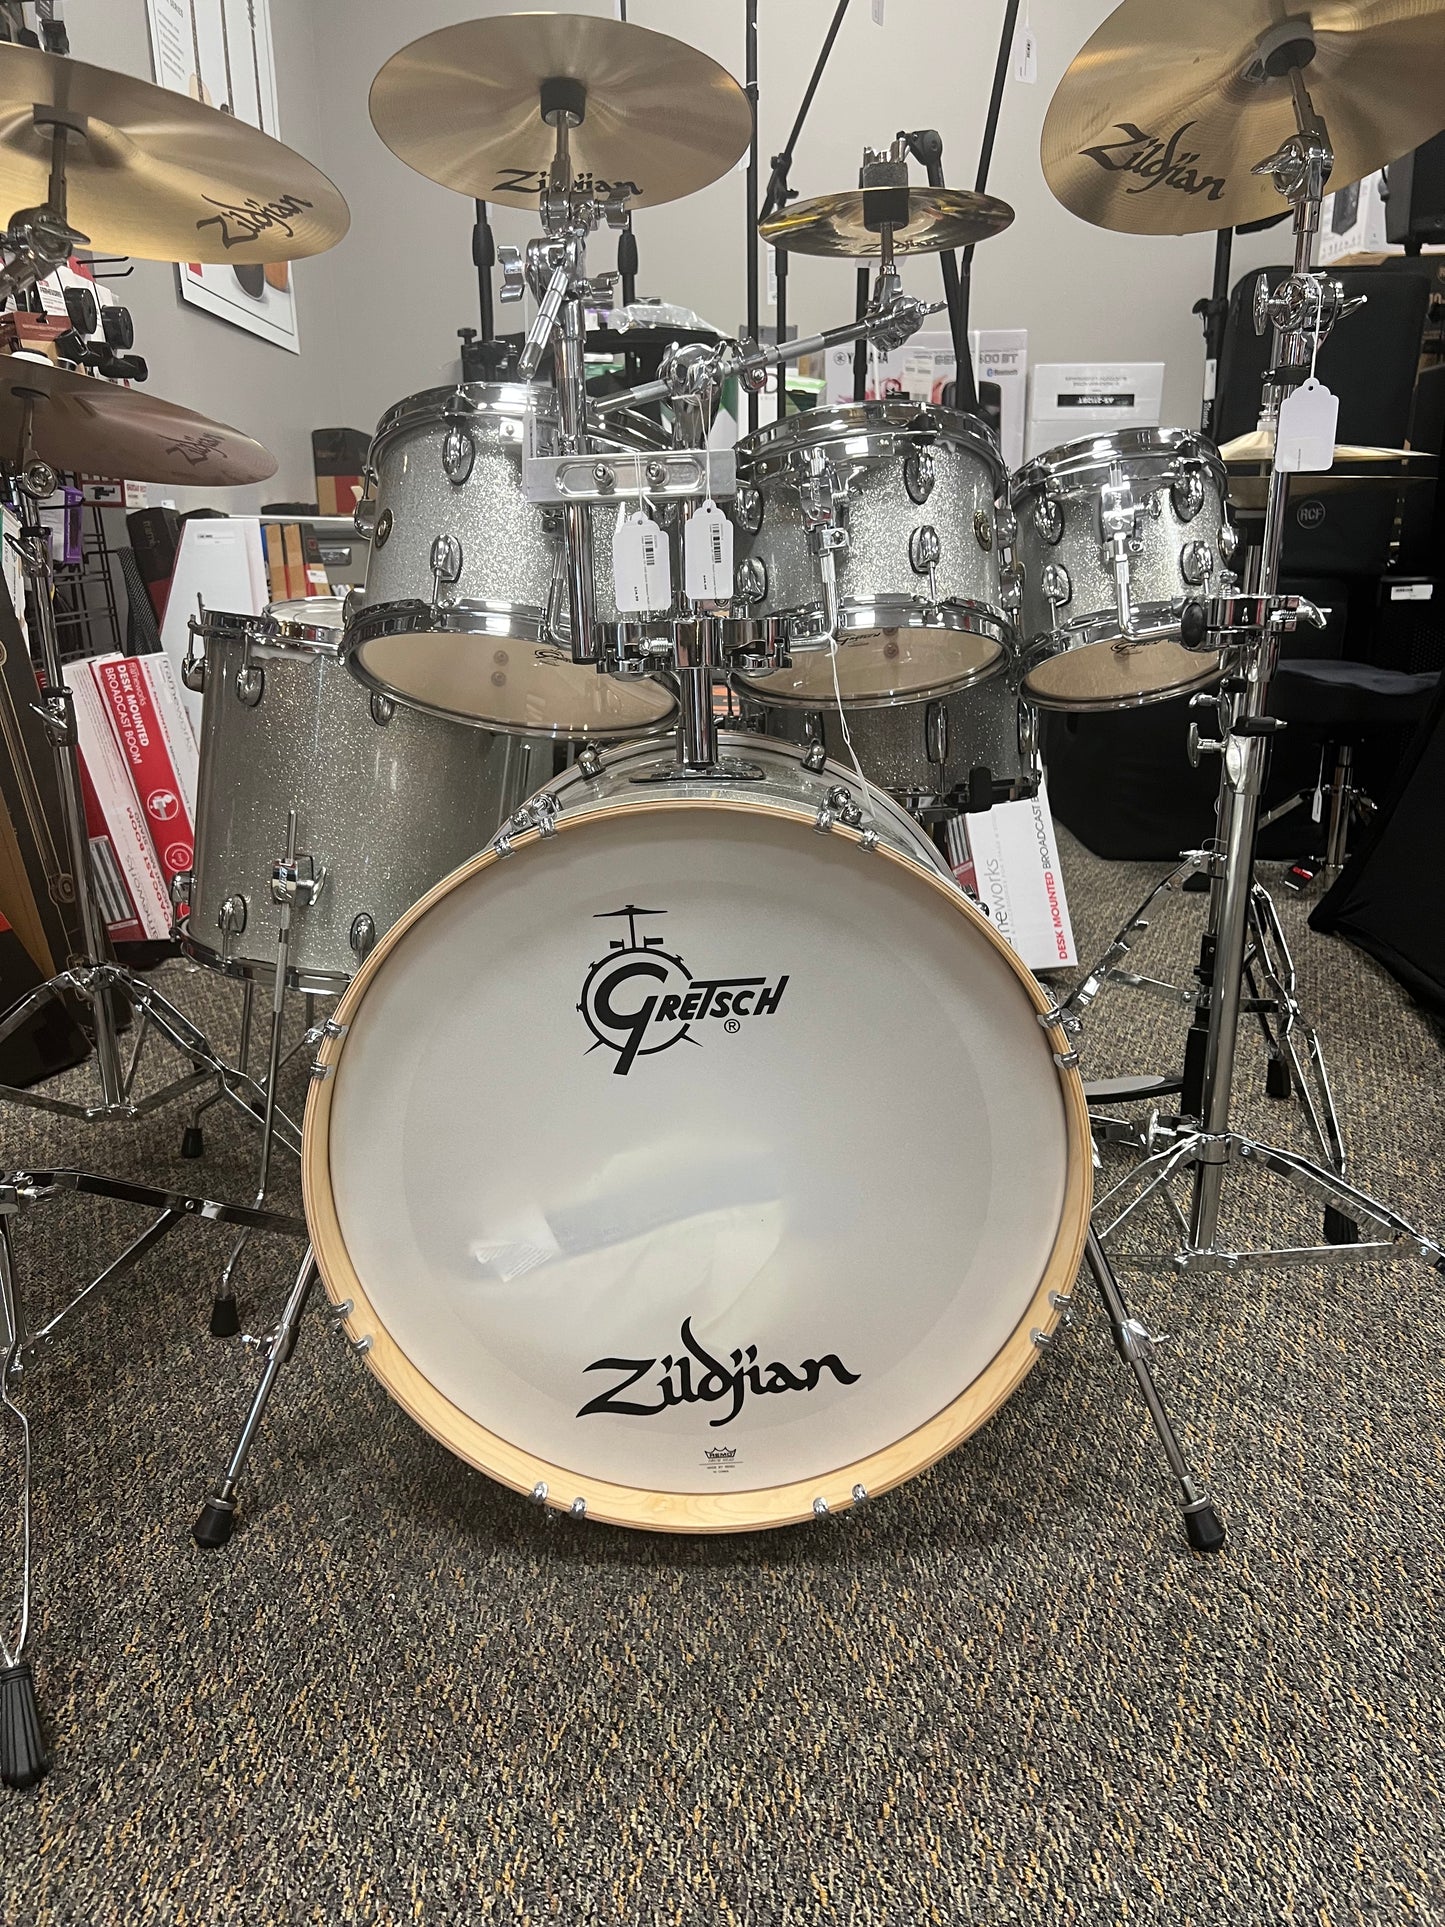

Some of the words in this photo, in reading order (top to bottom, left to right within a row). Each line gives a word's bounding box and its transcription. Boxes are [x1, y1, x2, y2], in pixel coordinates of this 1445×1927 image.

[1078, 120, 1227, 201] Zildjian
[196, 194, 313, 249] Zildjian
[156, 432, 228, 466] Zildjian
[1300, 507, 1323, 521] RCF
[117, 664, 132, 693] DESK
[126, 694, 150, 747] MOUNTED
[128, 662, 147, 706] frameworks
[105, 667, 132, 729] BROADCAST
[124, 730, 143, 765] BOOM
[126, 807, 145, 852] BOOM
[1031, 804, 1052, 870] BROADCAST
[983, 858, 1012, 944] meworks
[1044, 871, 1063, 928] MOUNTED
[1056, 930, 1068, 960] DESK
[575, 1315, 862, 1427] Zildjian
